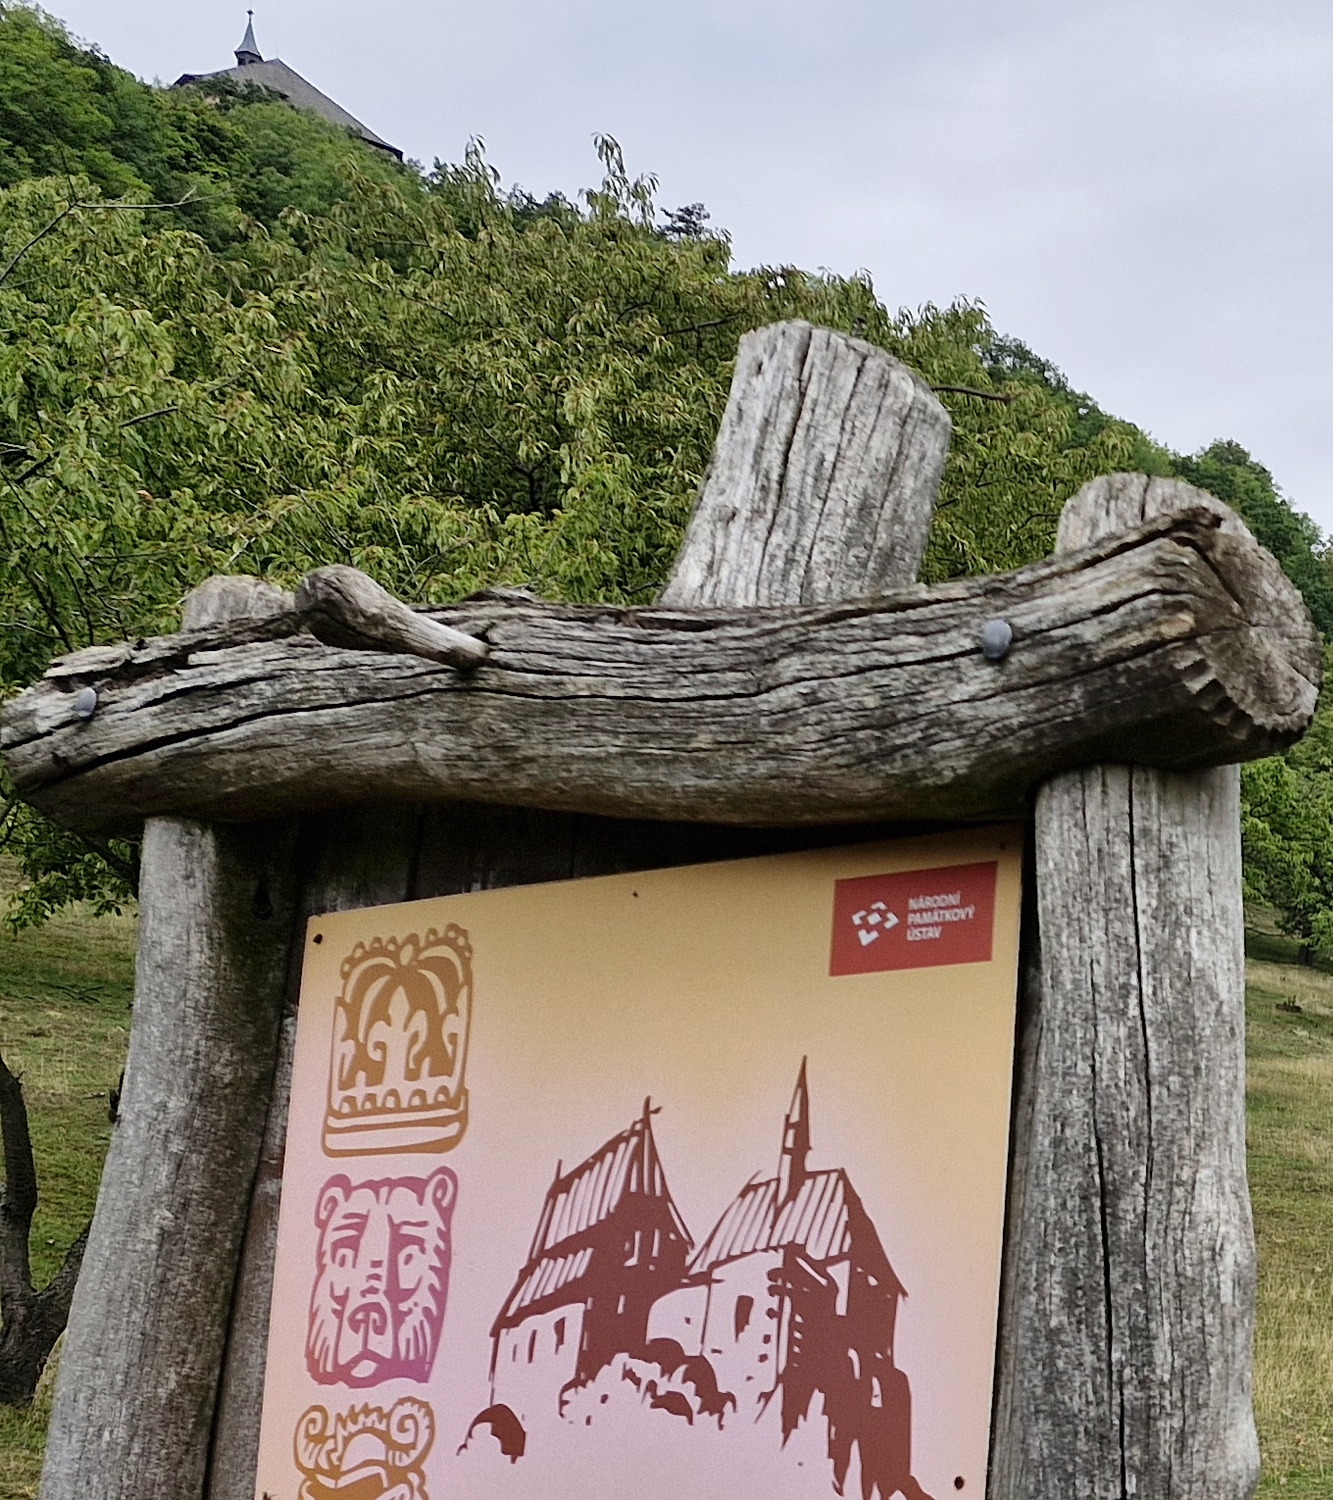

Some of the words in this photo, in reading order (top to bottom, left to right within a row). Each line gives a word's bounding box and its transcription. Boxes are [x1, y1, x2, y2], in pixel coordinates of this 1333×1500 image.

[908, 890, 960, 909] NÁRODNÍ
[907, 904, 975, 924] PAMÁTKOVÝ
[906, 925, 942, 940] ÚSTAV
